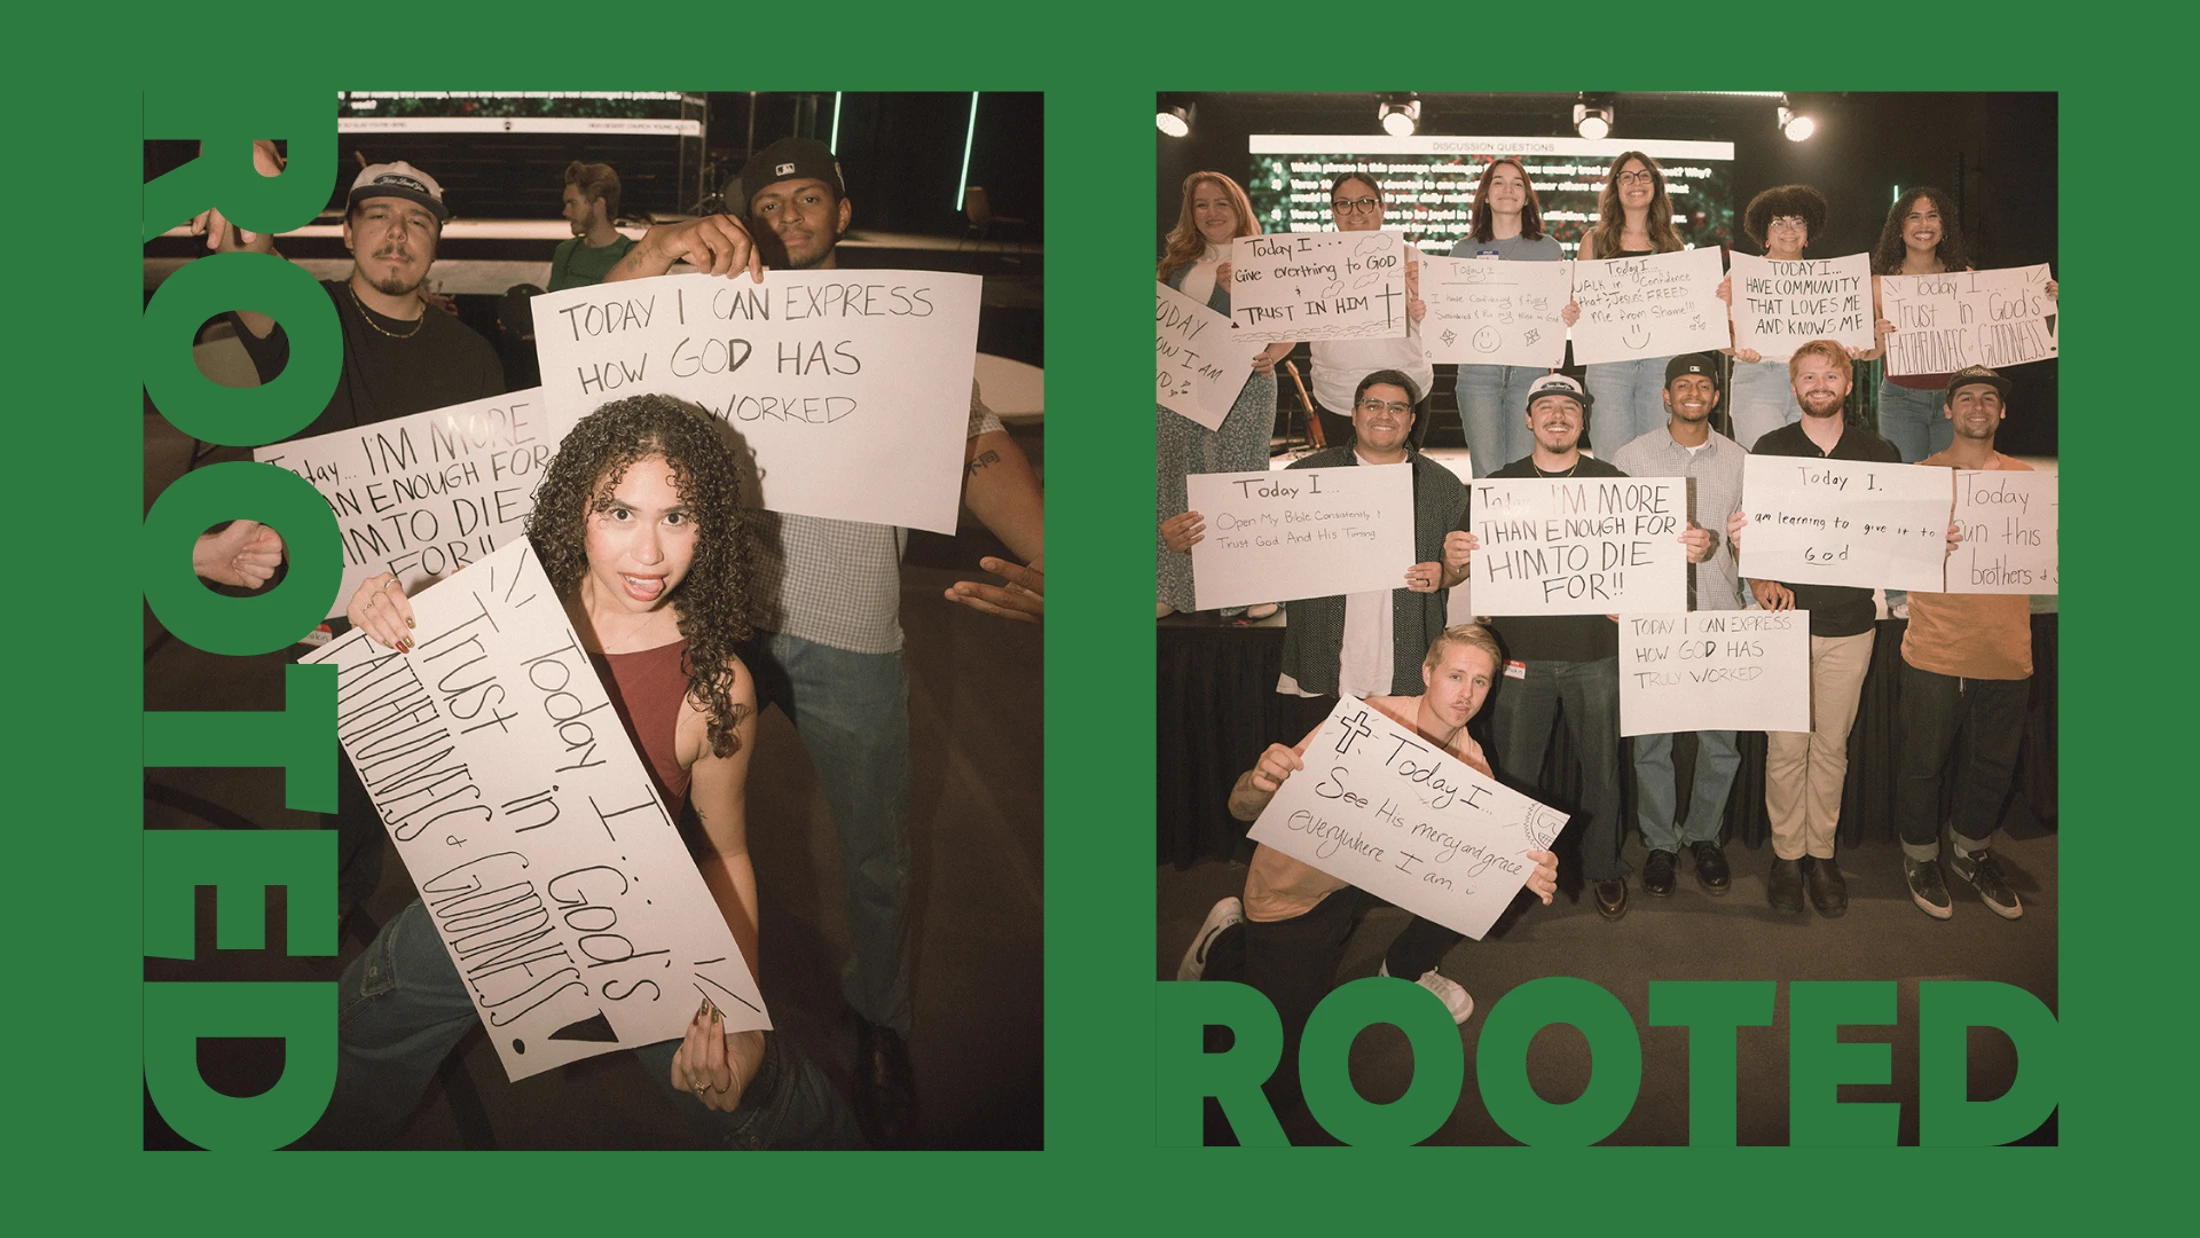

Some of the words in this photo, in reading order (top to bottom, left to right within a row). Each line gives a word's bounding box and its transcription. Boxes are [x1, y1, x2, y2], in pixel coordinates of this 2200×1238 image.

[1433, 142, 1494, 151] DISCUSSION
[1497, 143, 1555, 152] QUESTIONS
[1244, 237, 1293, 262] Today
[1235, 269, 1263, 283] Give
[1345, 257, 1362, 275] to
[1366, 255, 1397, 271] GOD
[1450, 262, 1487, 283] Today
[1604, 260, 1639, 284] Today
[1767, 260, 1817, 277] TODAY
[1578, 294, 1603, 309] that
[1646, 286, 1689, 301] FREED
[1613, 280, 1623, 289] in
[1746, 276, 1773, 295] HAVE
[1774, 276, 1861, 296] COMMUNITY
[1912, 275, 1958, 301] Today
[558, 294, 656, 342] TODAY
[676, 288, 687, 325] I
[712, 286, 770, 322] CAN
[785, 282, 935, 321] EXPRESS
[1236, 304, 1295, 326] TRUST
[1304, 300, 1328, 316] IN
[1335, 296, 1369, 315] HIM
[1430, 293, 1441, 305] I
[1746, 297, 1783, 315] THAT
[1791, 296, 1839, 316] LOVES
[1842, 294, 1861, 313] ME
[1890, 298, 1939, 330] Trust
[1958, 300, 1974, 325] in
[1988, 288, 2042, 322] God's
[1590, 310, 1613, 325] Me
[1619, 309, 1647, 321] from
[1754, 318, 1784, 335] AND
[1788, 318, 1837, 336] KNOWS
[1839, 313, 1864, 332] ME
[577, 353, 647, 396] HOW
[669, 337, 753, 380] GOD
[778, 339, 862, 376] HAS
[1181, 349, 1200, 370] I
[1197, 363, 1224, 385] AM
[696, 393, 857, 425] WORKED
[361, 427, 418, 476] I'M
[430, 403, 536, 463] MORE
[366, 460, 480, 514] ENOUGH
[491, 444, 552, 482] FOR
[1232, 477, 1300, 500] Today
[1796, 466, 1849, 492] Today
[1551, 483, 1587, 515] I'M
[1598, 483, 1670, 515] MORE
[1957, 472, 2030, 515] Today
[381, 508, 439, 550] TO
[452, 486, 531, 538] DIE
[1216, 512, 1257, 532] Open
[1260, 512, 1279, 527] My
[1314, 509, 1371, 522] Consistently
[1479, 518, 1538, 546] THAN
[1545, 516, 1626, 543] ENOUGH
[1634, 514, 1678, 536] FOR
[1754, 511, 1772, 522] am
[1778, 511, 1827, 531] learning
[1833, 516, 1850, 530] to
[1863, 523, 1888, 536] give
[1897, 527, 1910, 536] it
[1920, 527, 1936, 538] to
[2001, 516, 2042, 547] this
[1216, 536, 1249, 550] Trust
[1255, 535, 1280, 548] God
[1286, 530, 1312, 544] And
[1317, 528, 1338, 541] His
[1341, 526, 1377, 542] Timing
[1486, 548, 1549, 584] HIM
[1548, 544, 1590, 575] TO
[1601, 540, 1654, 572] DIE
[1804, 544, 1850, 562] God
[1971, 547, 2033, 586] brothers
[1542, 572, 1625, 604] FOR!!
[1630, 617, 1676, 637] TODAY
[1700, 617, 1726, 633] CAN
[1730, 615, 1793, 633] EXPRESS
[1635, 645, 1670, 664] HOW
[1678, 640, 1718, 661] GOD
[1726, 640, 1765, 659] HAS
[1633, 671, 1683, 690] TRULY
[1688, 665, 1765, 684] WORKED
[520, 627, 612, 774] Today
[1384, 732, 1460, 810] Today
[417, 591, 519, 735] Trust
[500, 785, 561, 833] in
[547, 864, 672, 1003] God's
[1314, 766, 1369, 809] See
[1374, 797, 1405, 829] His
[1410, 822, 1464, 865] mercy
[1467, 850, 1523, 879] grace
[1286, 809, 1385, 861] everywhere
[1394, 849, 1425, 876] I
